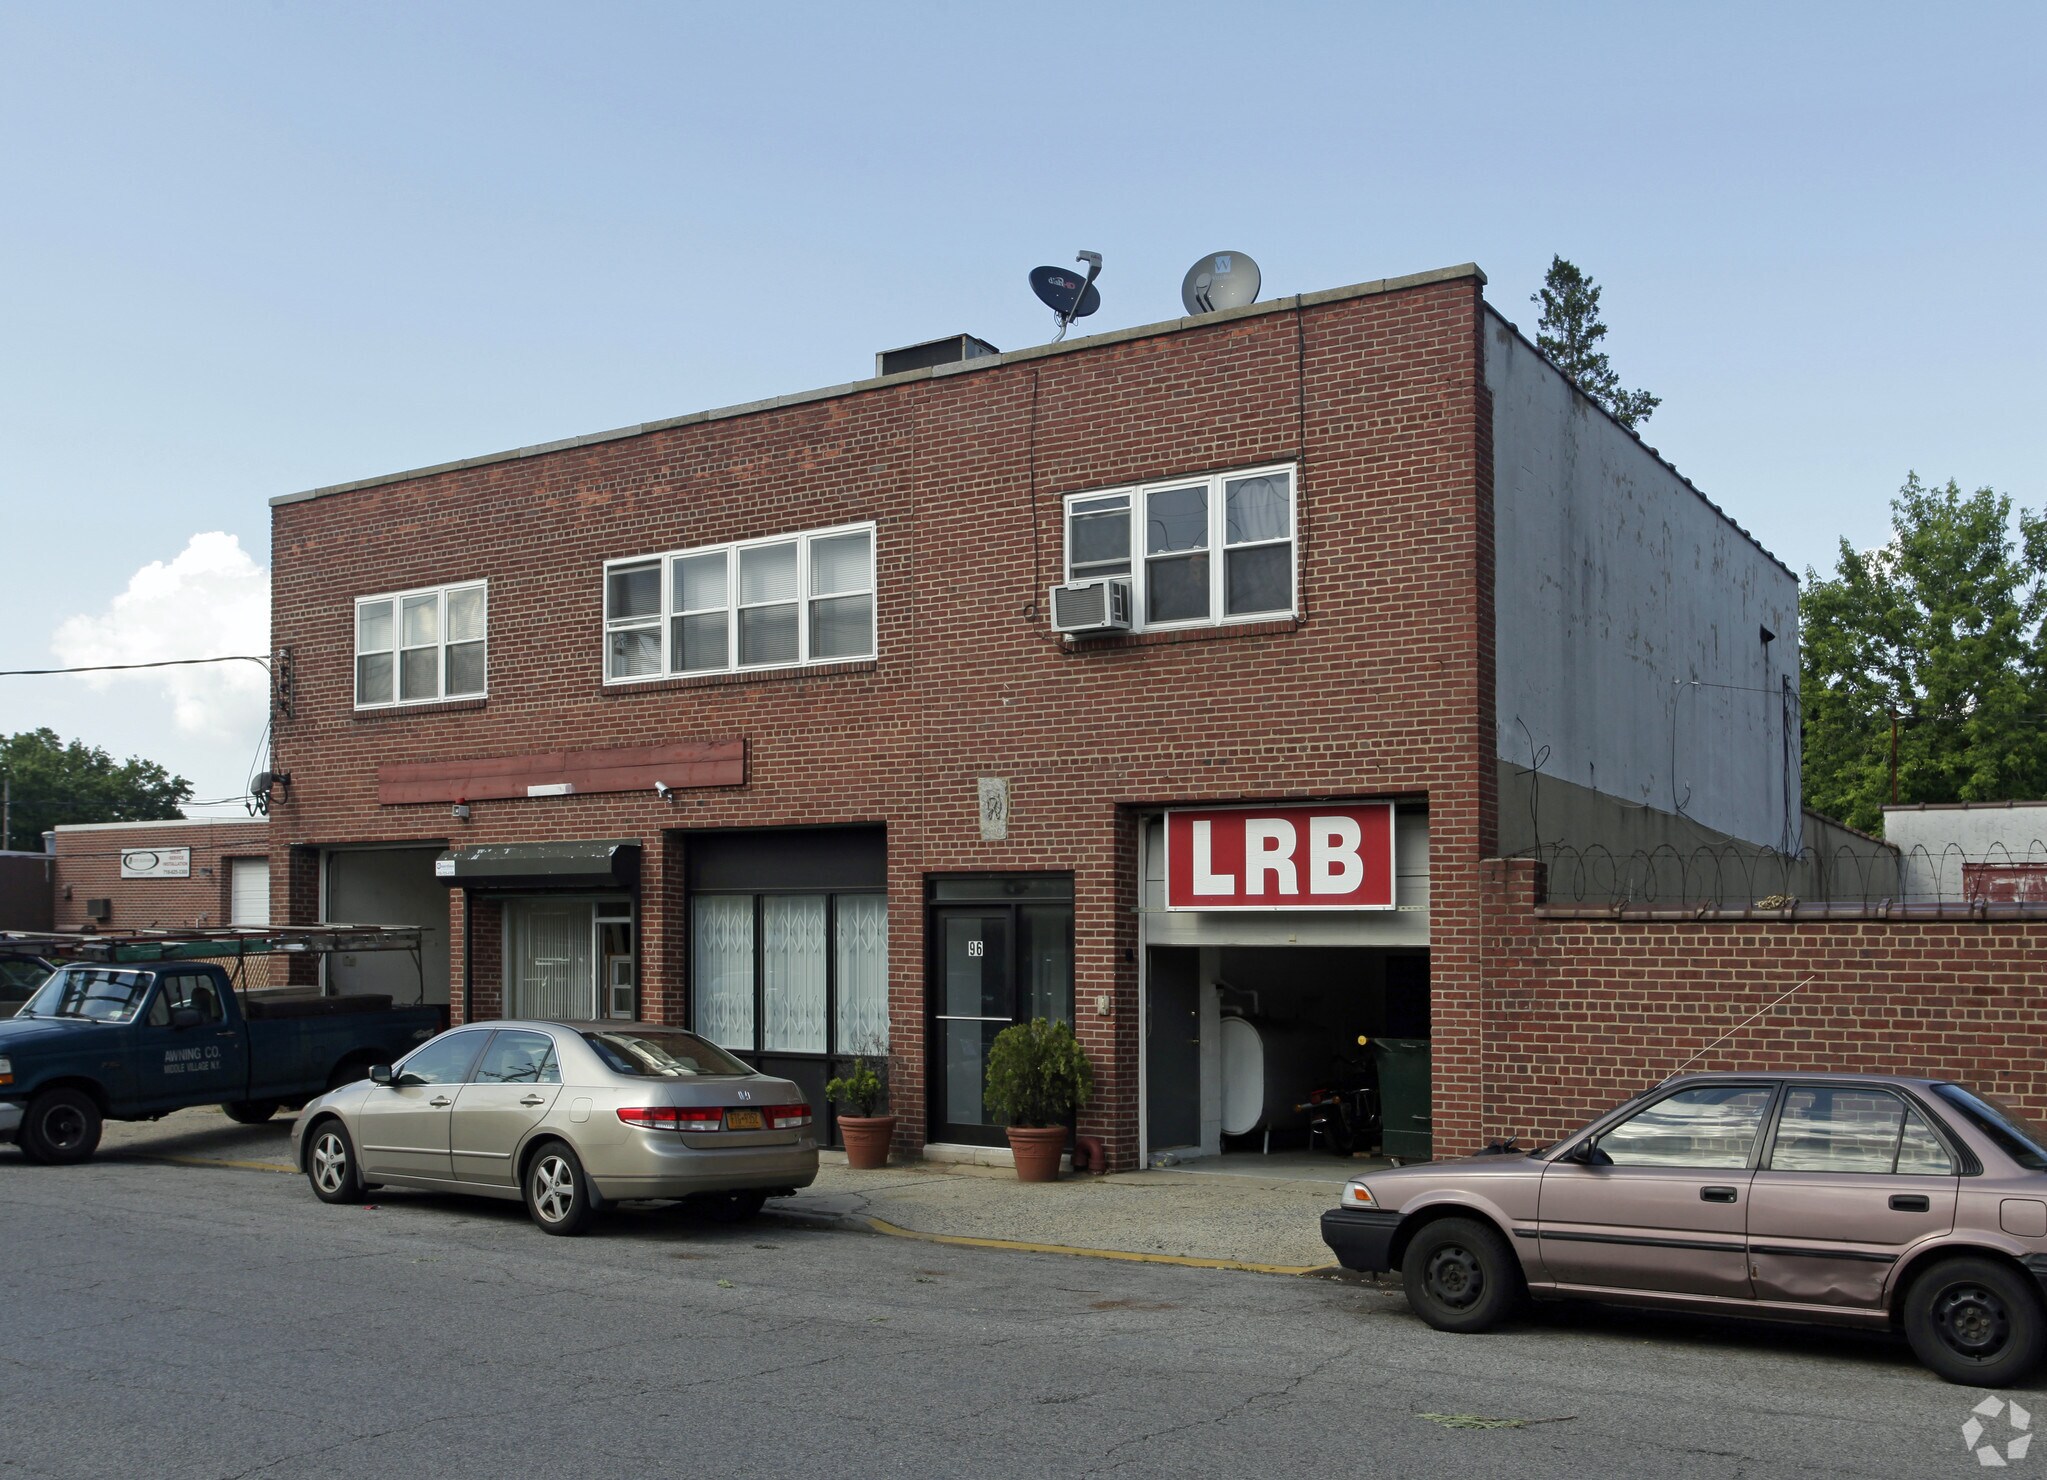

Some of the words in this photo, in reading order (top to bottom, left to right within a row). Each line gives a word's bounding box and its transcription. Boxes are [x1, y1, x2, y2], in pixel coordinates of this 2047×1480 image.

[1193, 816, 1364, 896] LRB
[969, 941, 983, 956] 96
[165, 1047, 202, 1062] AWNING
[204, 1045, 221, 1059] CO.
[164, 1063, 185, 1074] MIDDLE
[187, 1061, 209, 1072] VILLAGE
